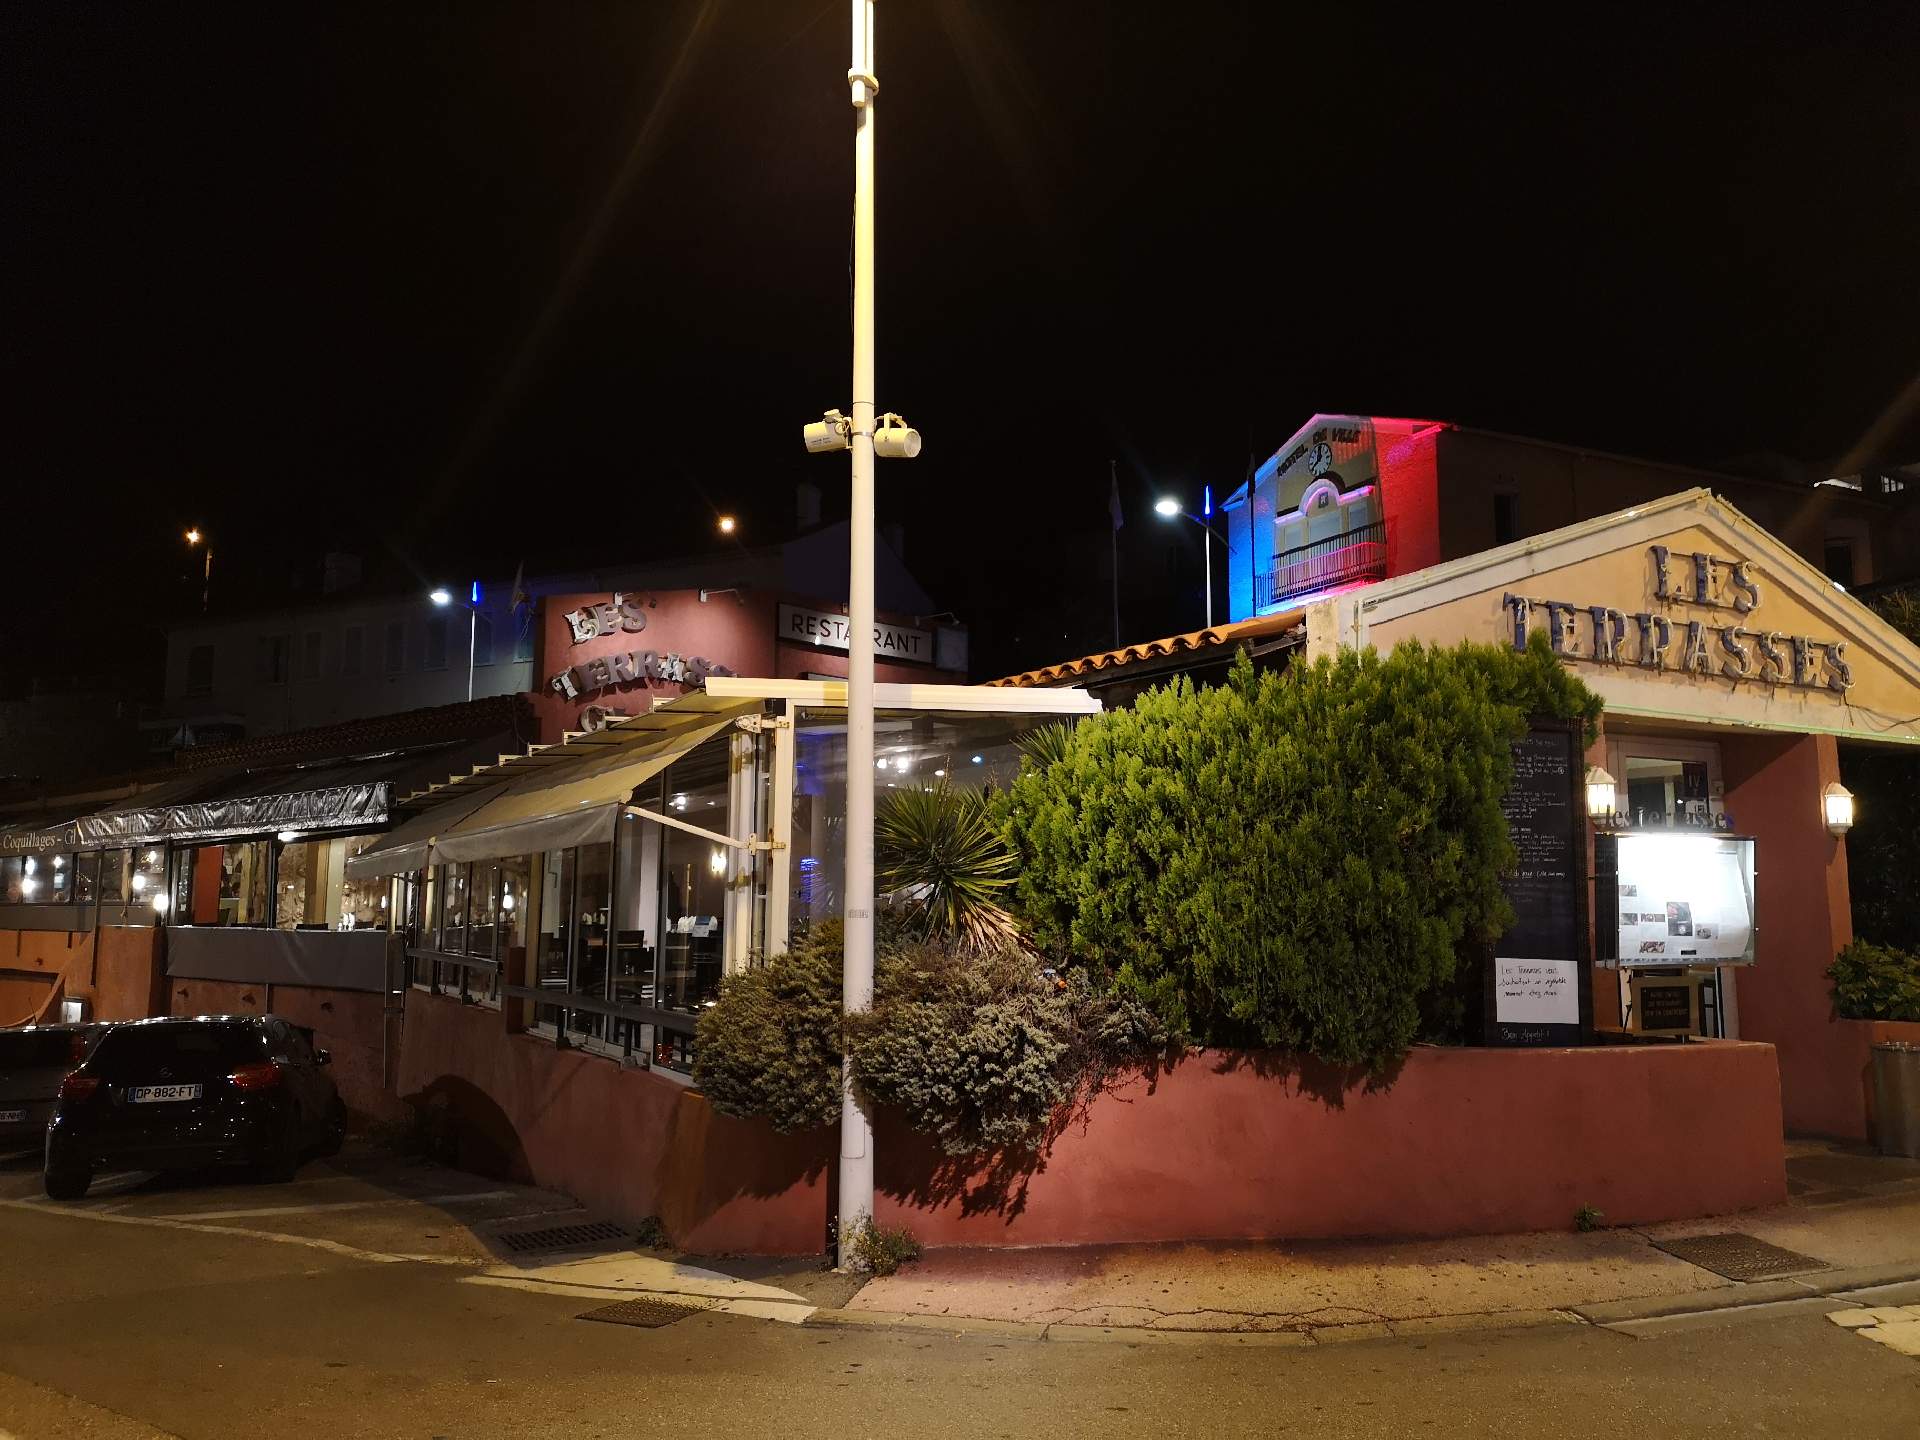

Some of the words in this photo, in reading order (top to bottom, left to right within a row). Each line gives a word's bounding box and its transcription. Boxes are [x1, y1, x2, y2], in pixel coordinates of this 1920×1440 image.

[1332, 427, 1361, 443] VILLE
[1652, 545, 1762, 612] LES
[563, 601, 647, 644] LES
[792, 613, 922, 655] RESTRANT
[1503, 591, 1857, 692] TERRASSES
[2, 832, 56, 852] Coquillages
[136, 1086, 194, 1099] DP-882-FT
